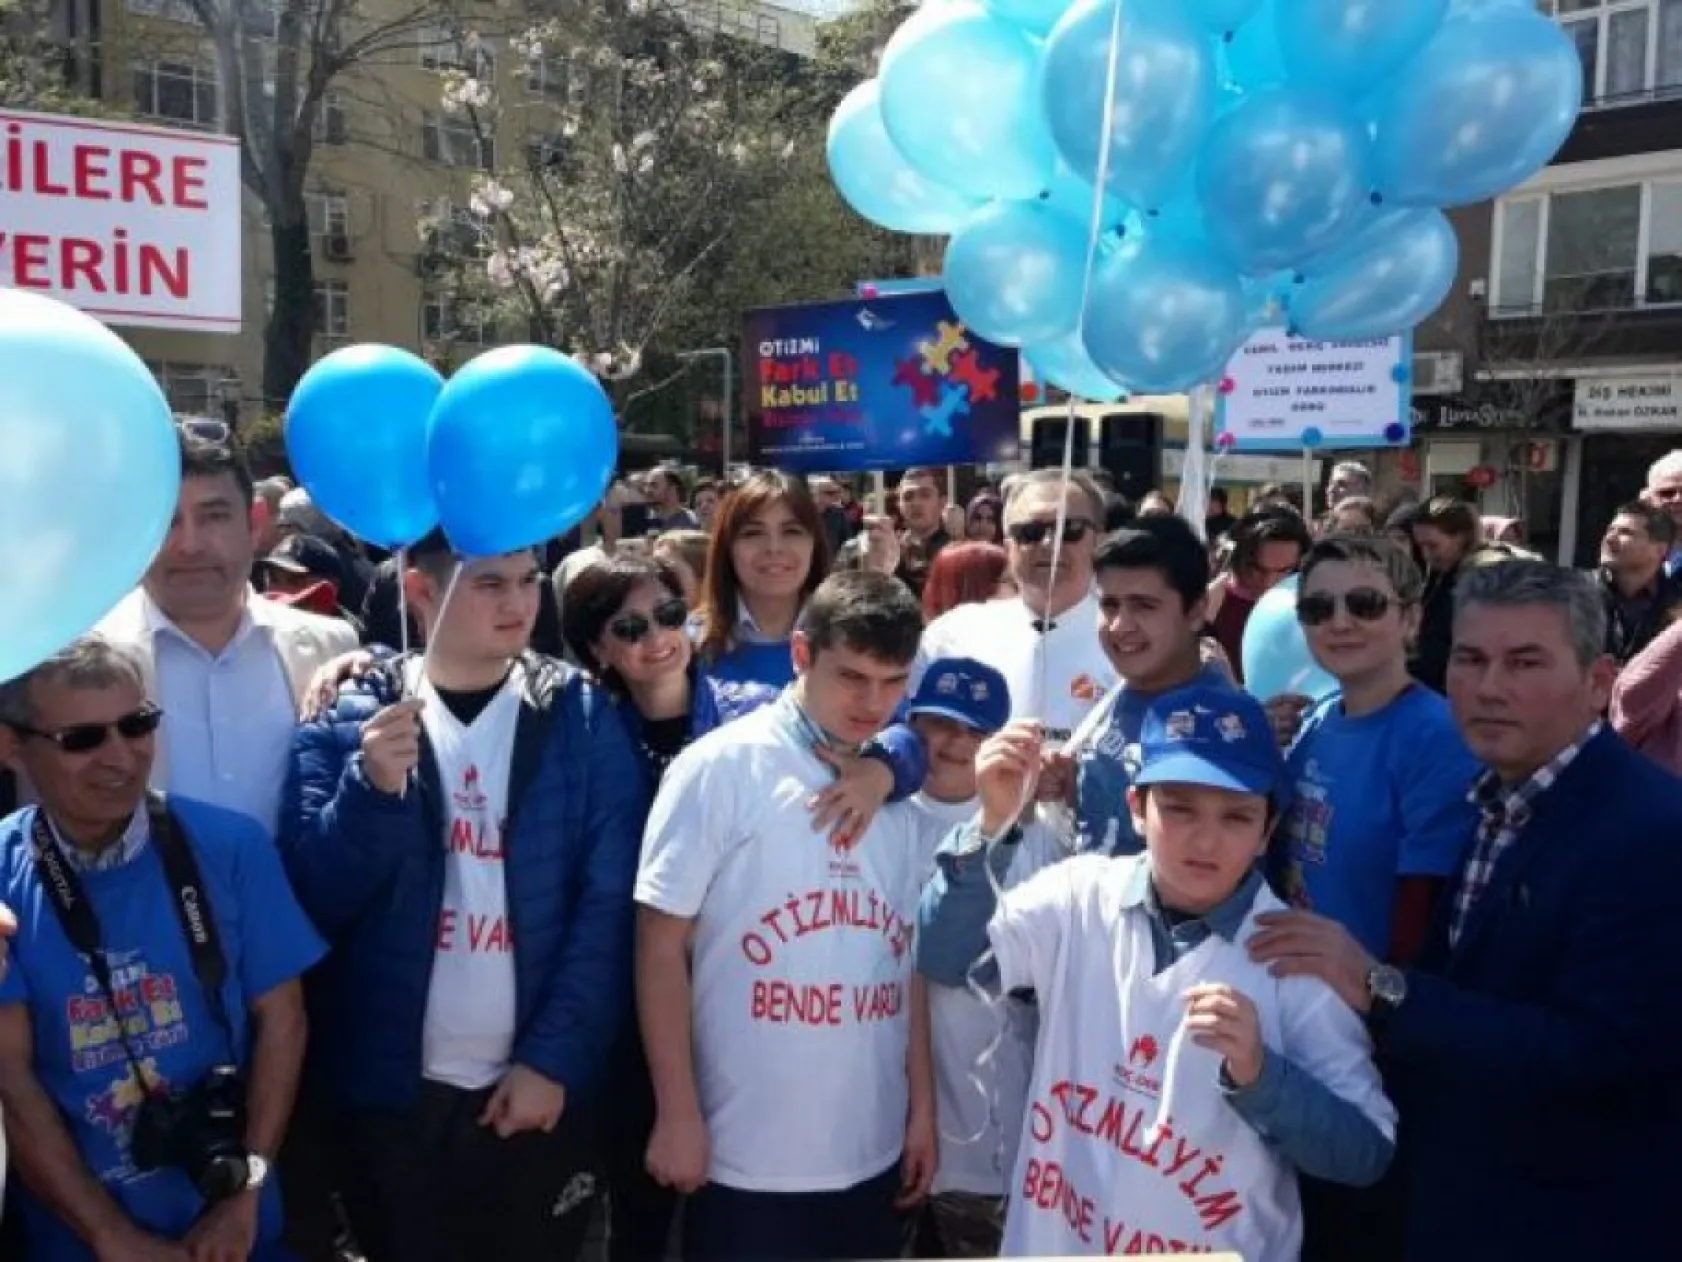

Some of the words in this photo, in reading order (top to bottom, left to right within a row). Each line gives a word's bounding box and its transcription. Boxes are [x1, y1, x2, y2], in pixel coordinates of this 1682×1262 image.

[3, 122, 208, 210] İLERE
[761, 380, 828, 408] Kabul
[834, 379, 859, 402] Et
[181, 885, 209, 943] Canon
[752, 979, 843, 1026] BENDE
[1031, 1079, 1243, 1231] OTZMLİYİM
